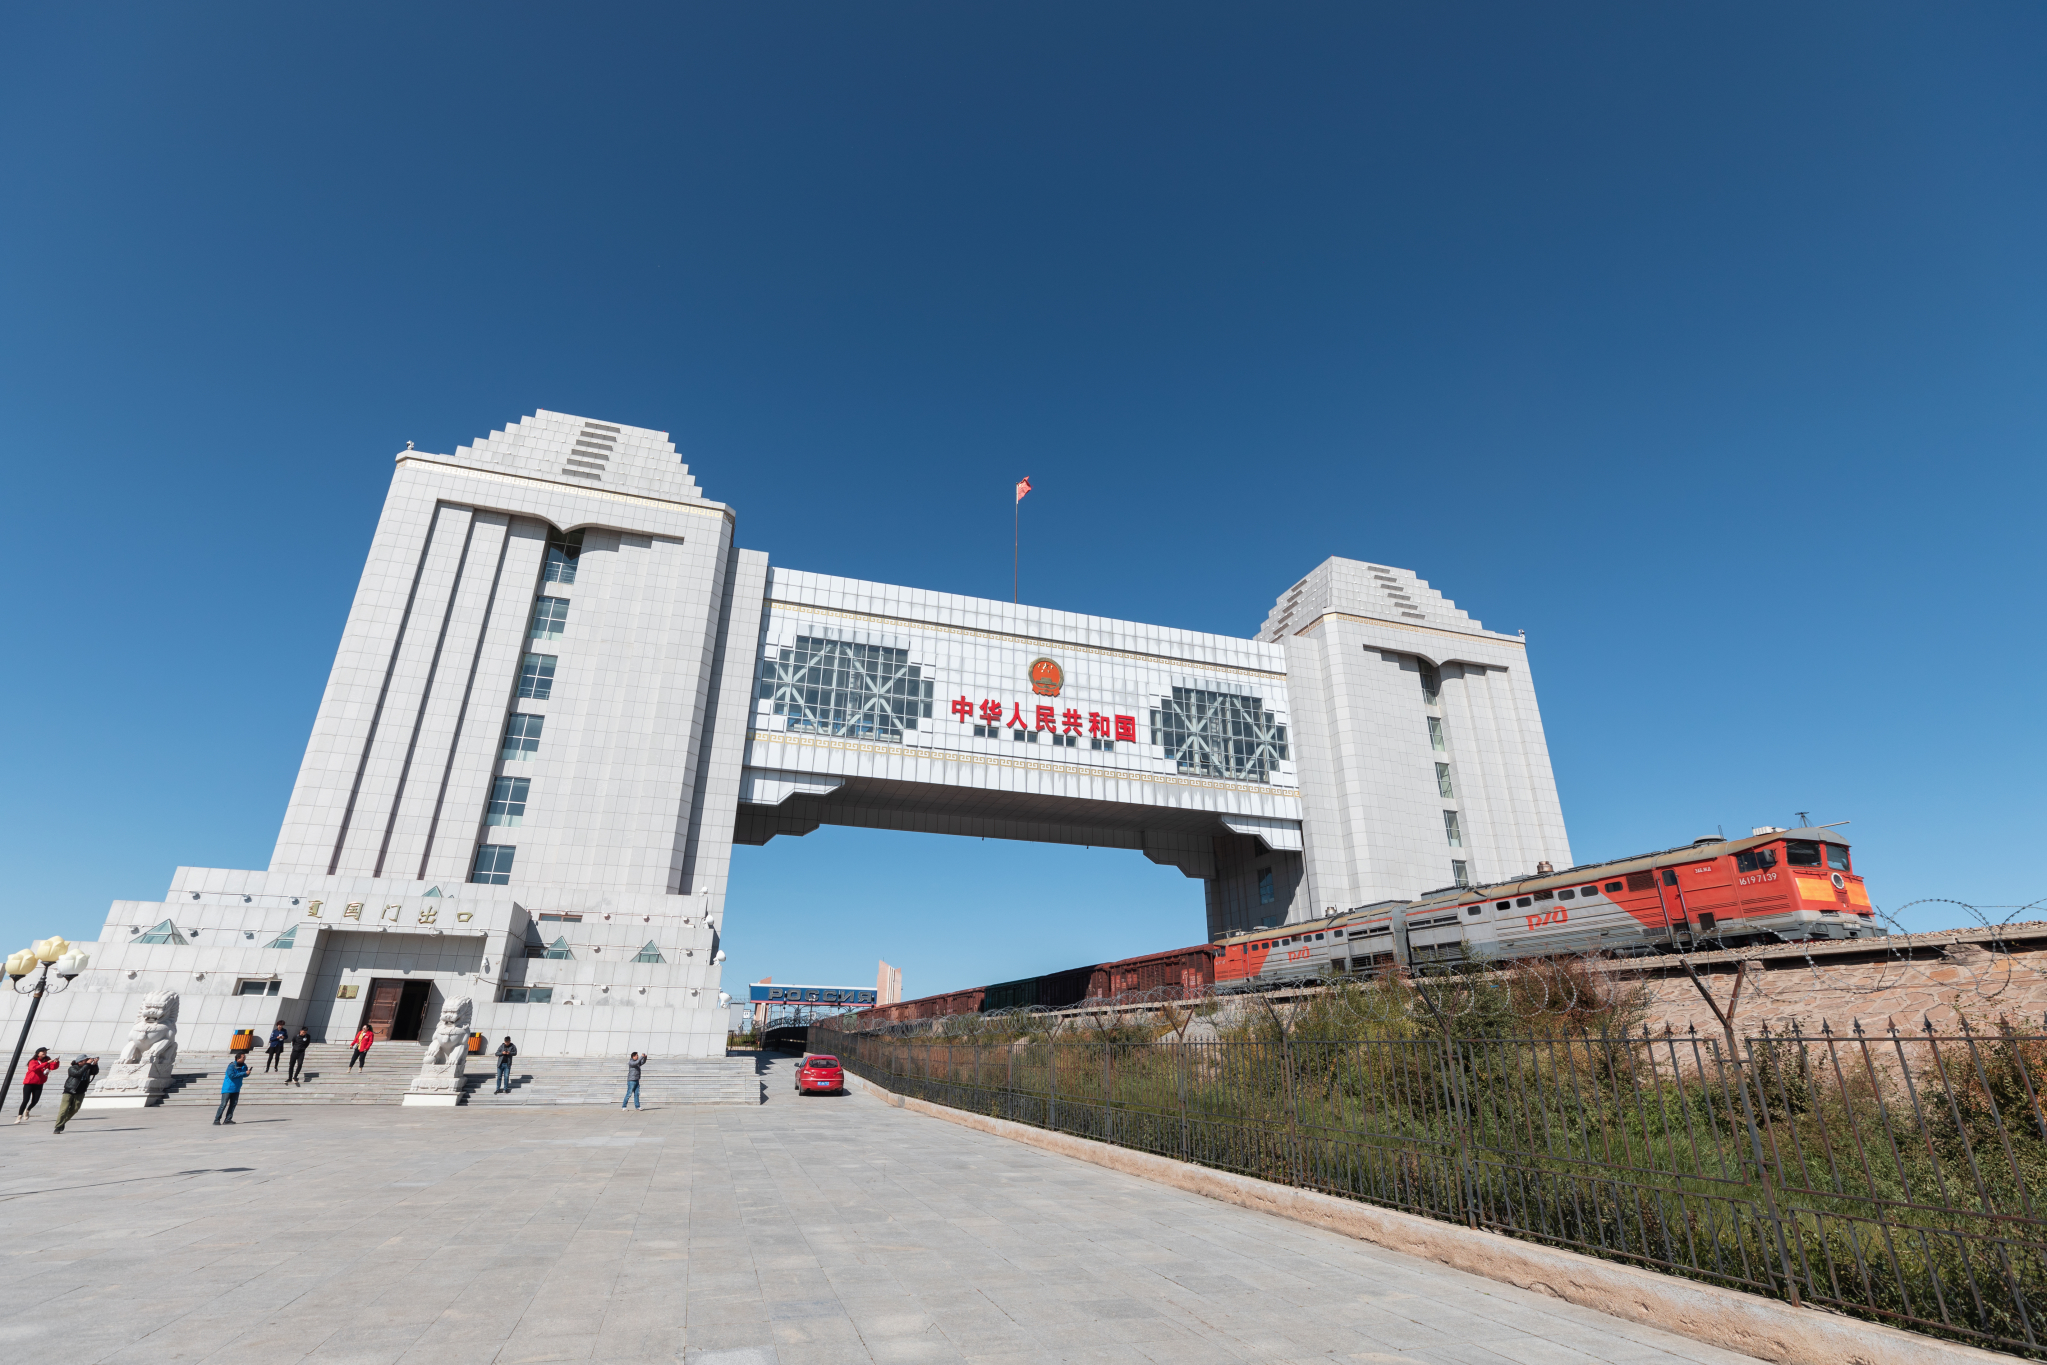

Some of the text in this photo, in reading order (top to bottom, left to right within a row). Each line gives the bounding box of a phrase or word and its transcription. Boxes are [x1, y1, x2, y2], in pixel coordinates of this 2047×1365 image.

[951, 695, 1137, 743] 中华人民共和国
[1739, 872, 1778, 886] 16197139
[343, 901, 474, 925] 国门出口
[768, 987, 873, 1004] РОССИЯ
